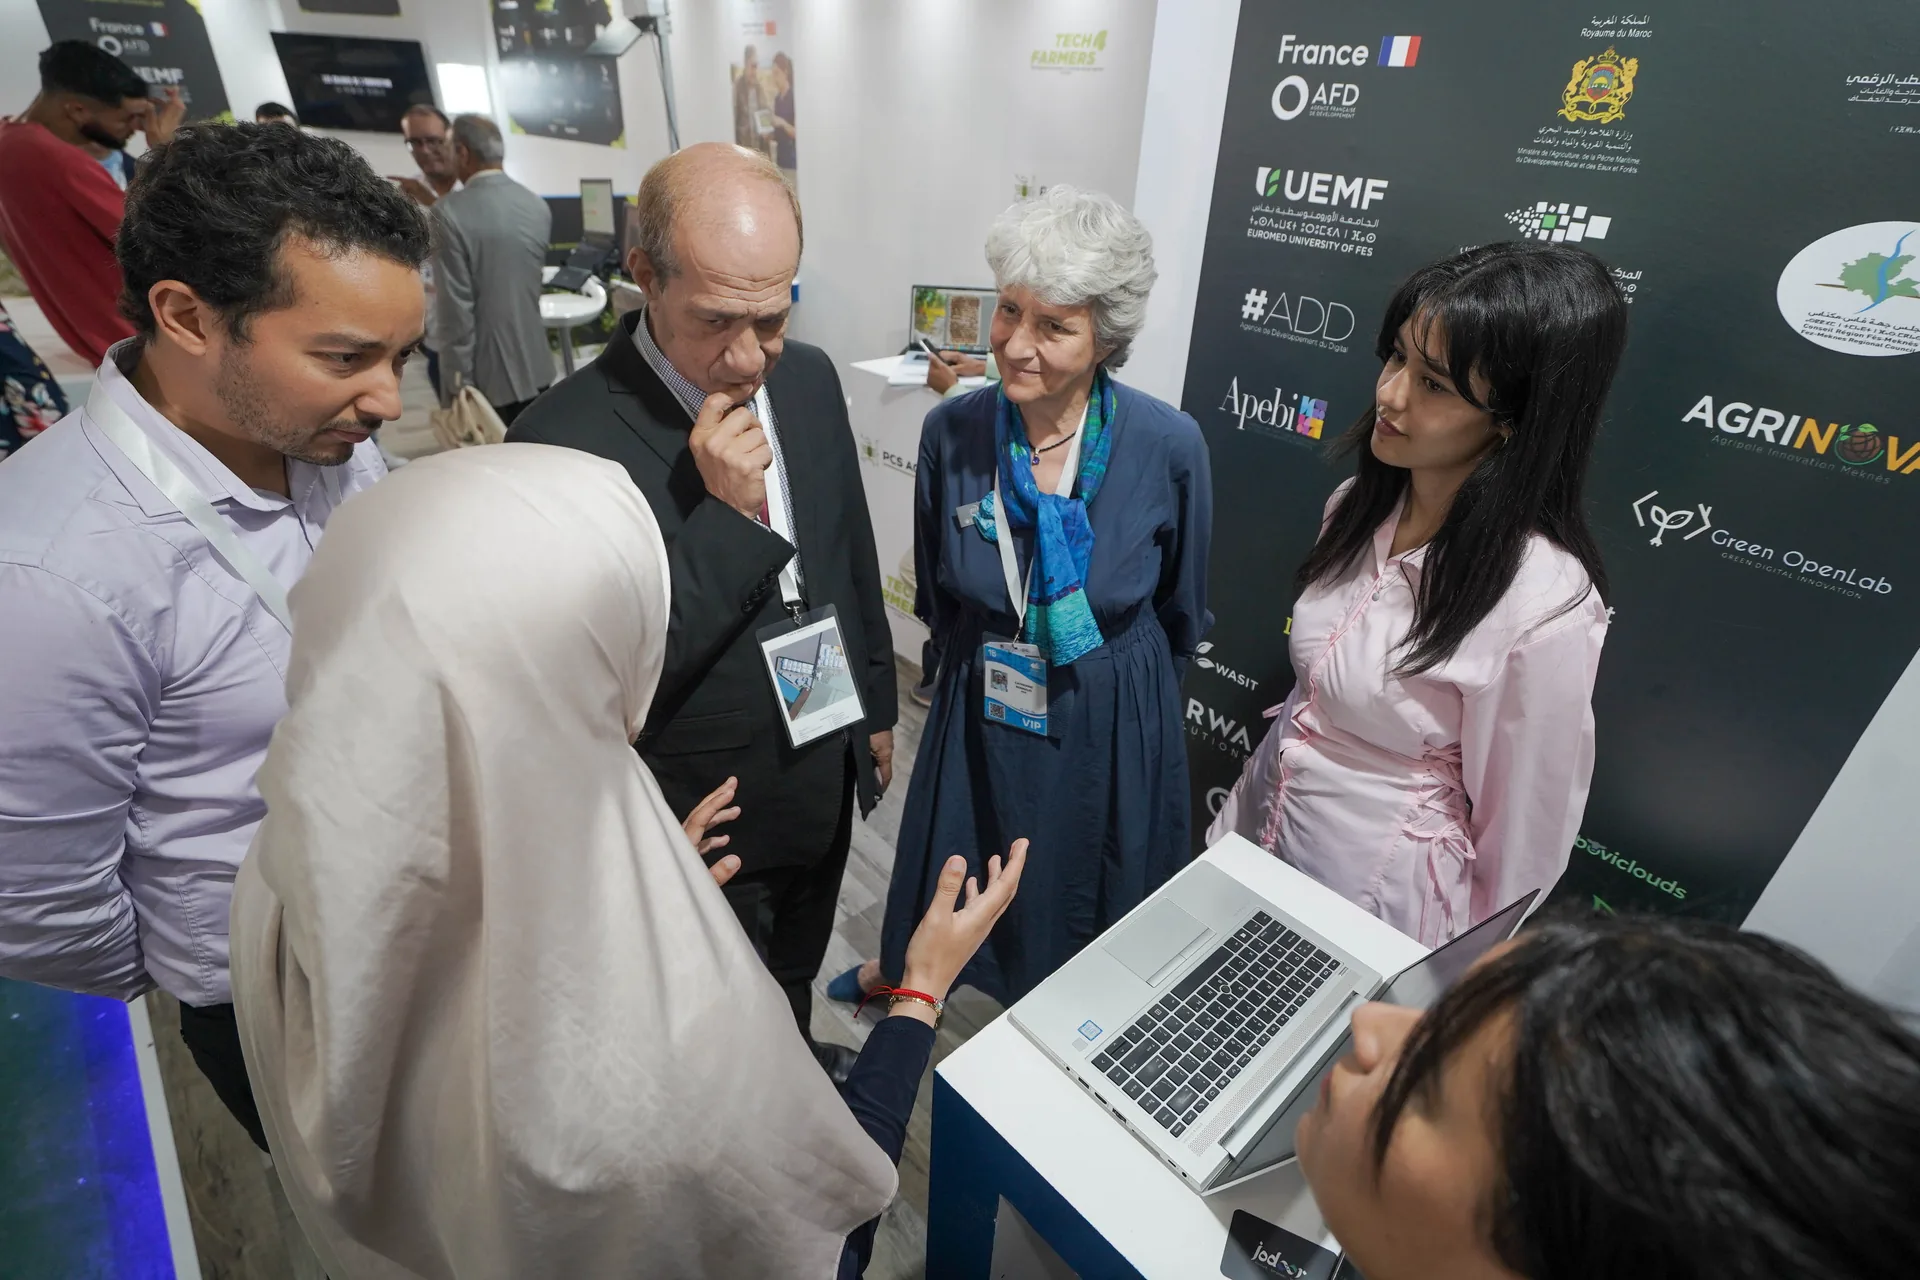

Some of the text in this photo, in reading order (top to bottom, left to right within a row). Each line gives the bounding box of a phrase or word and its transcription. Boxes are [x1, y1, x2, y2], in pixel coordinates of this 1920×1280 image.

[1590, 13, 1650, 28] المملكة المغربية
[1580, 27, 1653, 39] Royaume du Maroc
[1278, 34, 1369, 66] France
[133, 66, 184, 85] EMF
[1846, 73, 1895, 87] الرقمي
[1311, 82, 1360, 106] AFD
[1582, 153, 1589, 161] de
[1597, 163, 1611, 172] Eaux
[1284, 169, 1389, 210] UEMF
[1247, 228, 1374, 257] EUROMED UNIVERSITY OF FES
[1241, 287, 1355, 342] #ADD
[1239, 321, 1349, 353] Agence de Développement du Digital
[1803, 323, 1834, 333] Conseil
[1835, 329, 1865, 339] Région
[1848, 337, 1883, 348] Regional
[1884, 341, 1917, 353] Council
[1219, 375, 1299, 431] Apebi
[883, 450, 903, 468] PCS
[1711, 434, 1892, 485] Agripole Innovation Meknès
[1711, 529, 1893, 595] Green OpenLab
[1721, 552, 1862, 600] GREEN DIGITAL INNOVATION
[1215, 662, 1259, 691] WASIT
[1022, 717, 1042, 730] VIP
